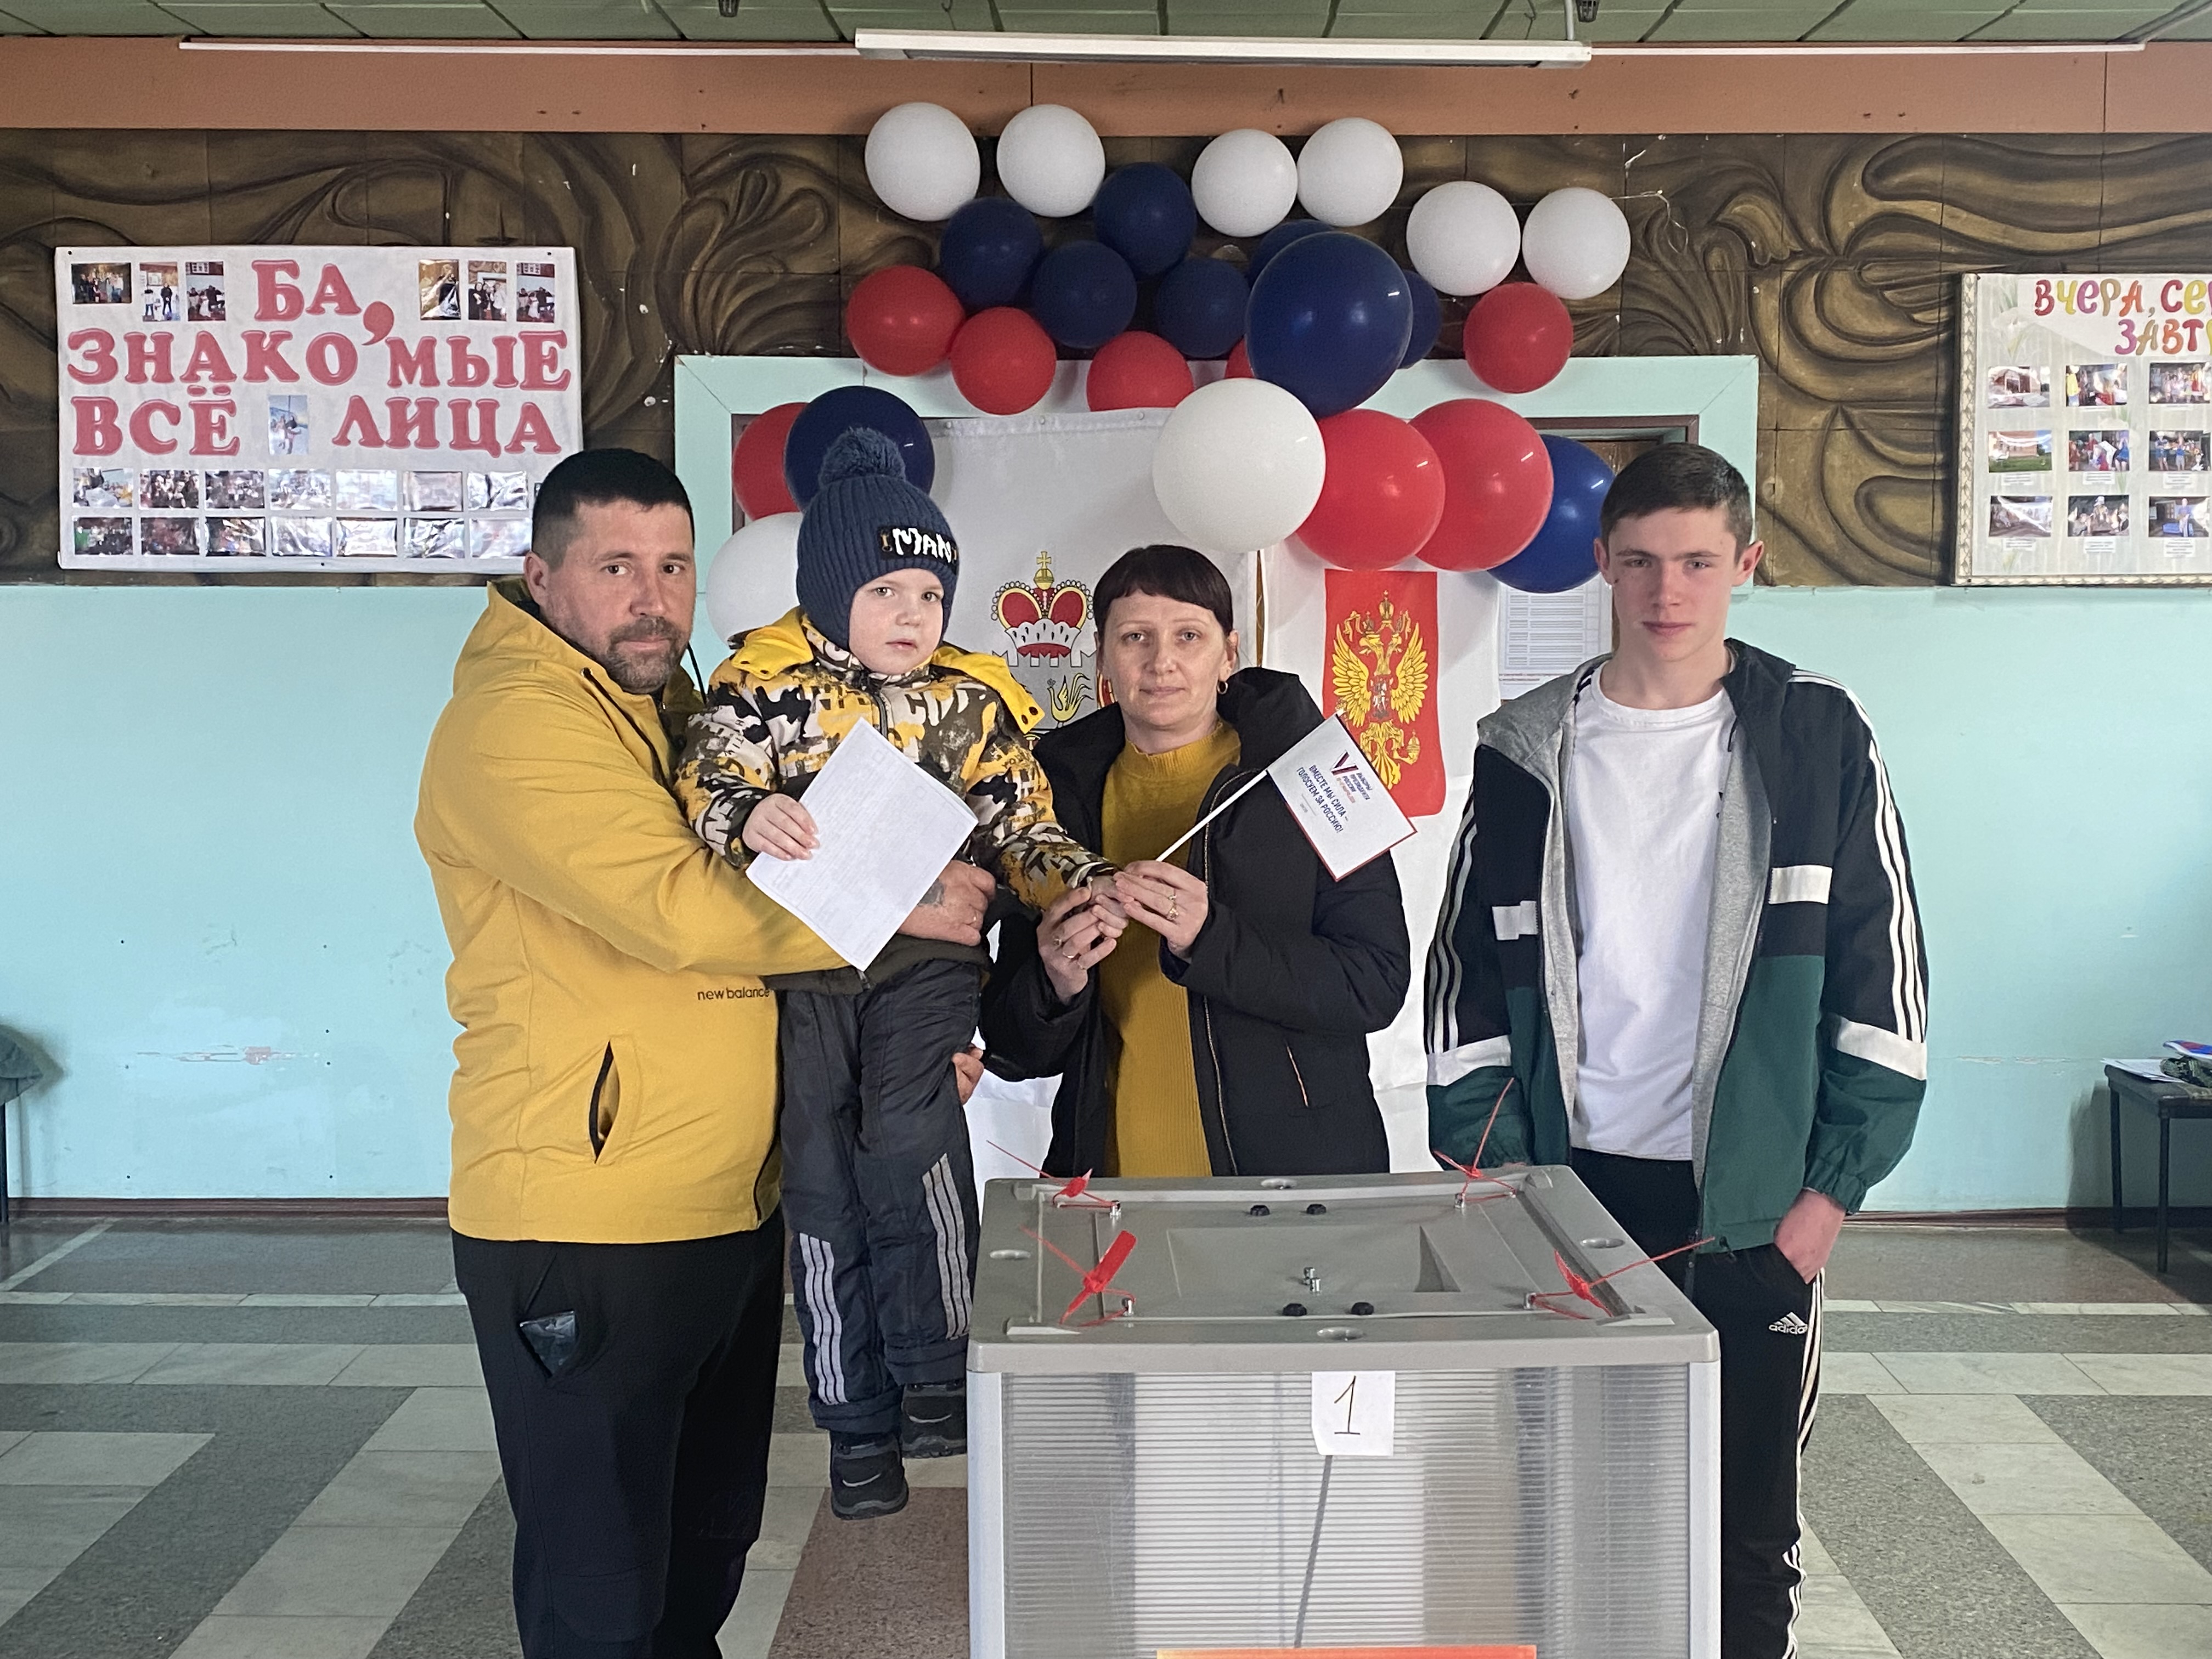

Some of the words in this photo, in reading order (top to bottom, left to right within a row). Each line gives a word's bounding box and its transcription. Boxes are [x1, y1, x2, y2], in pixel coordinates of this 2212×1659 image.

[252, 259, 394, 345] БА,
[2160, 279, 2212, 314] СЕ
[67, 328, 571, 391] ЗНАКОМЫЕ
[2115, 319, 2212, 356] ЗАВТ
[70, 384, 240, 456] ВСЁ
[331, 395, 562, 458] ЛИЦА
[892, 527, 952, 563] MAN
[1296, 766, 1319, 797] ГОЛОСУЕМ
[1314, 795, 1324, 805] ЗА
[1320, 804, 1344, 833] РОССИЮ!
[1309, 765, 1328, 789] ВМЕСТЕ
[1323, 786, 1335, 800] МЫ
[1331, 798, 1347, 817] СИЛА
[697, 990, 724, 1001] new
[726, 986, 770, 999] balance
[1334, 1375, 1361, 1435] 1
